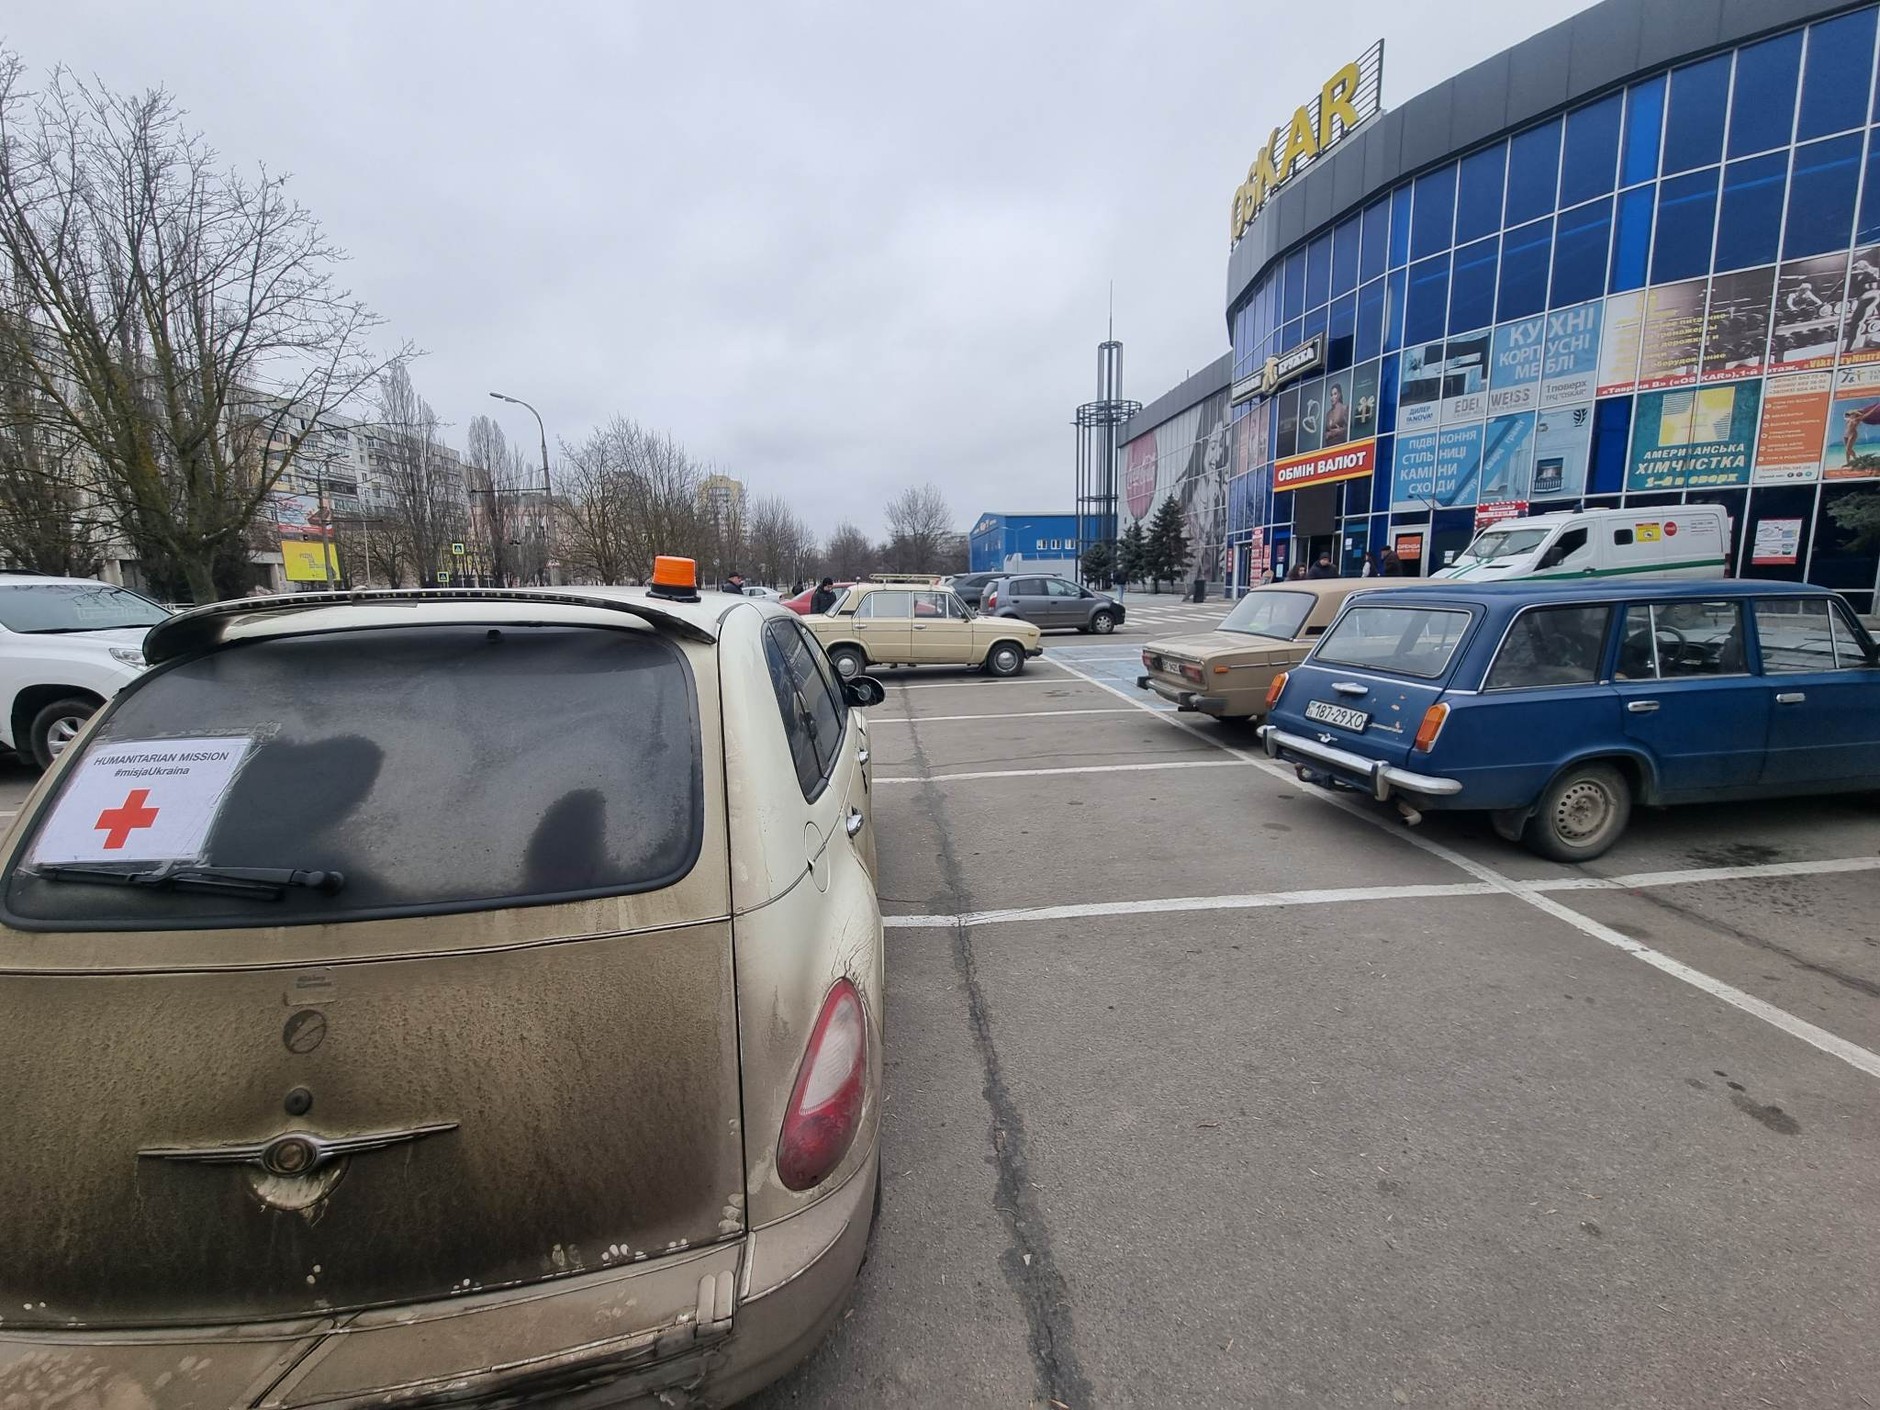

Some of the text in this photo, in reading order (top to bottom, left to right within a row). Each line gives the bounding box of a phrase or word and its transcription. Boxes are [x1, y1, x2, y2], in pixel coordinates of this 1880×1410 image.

[1231, 62, 1361, 241] OSKAR
[1509, 307, 1594, 348] КУХНІ
[1499, 333, 1590, 367] КОРПУСНІ
[1515, 354, 1574, 380] МЕБЛІ
[1408, 430, 1477, 450] ПІДВІКОННЯ
[1402, 446, 1467, 465] СТІЛЬНИЦІ
[1634, 455, 1745, 475] ХІМЧИСТКА
[1278, 451, 1367, 482] ОБМІН ВАЛЮТ
[1400, 463, 1458, 481] КАМІНИ
[1408, 479, 1456, 495] СХОДИ
[93, 751, 230, 767] HUMANITARIAN MISSION
[114, 766, 190, 778] #misjaUkraina
